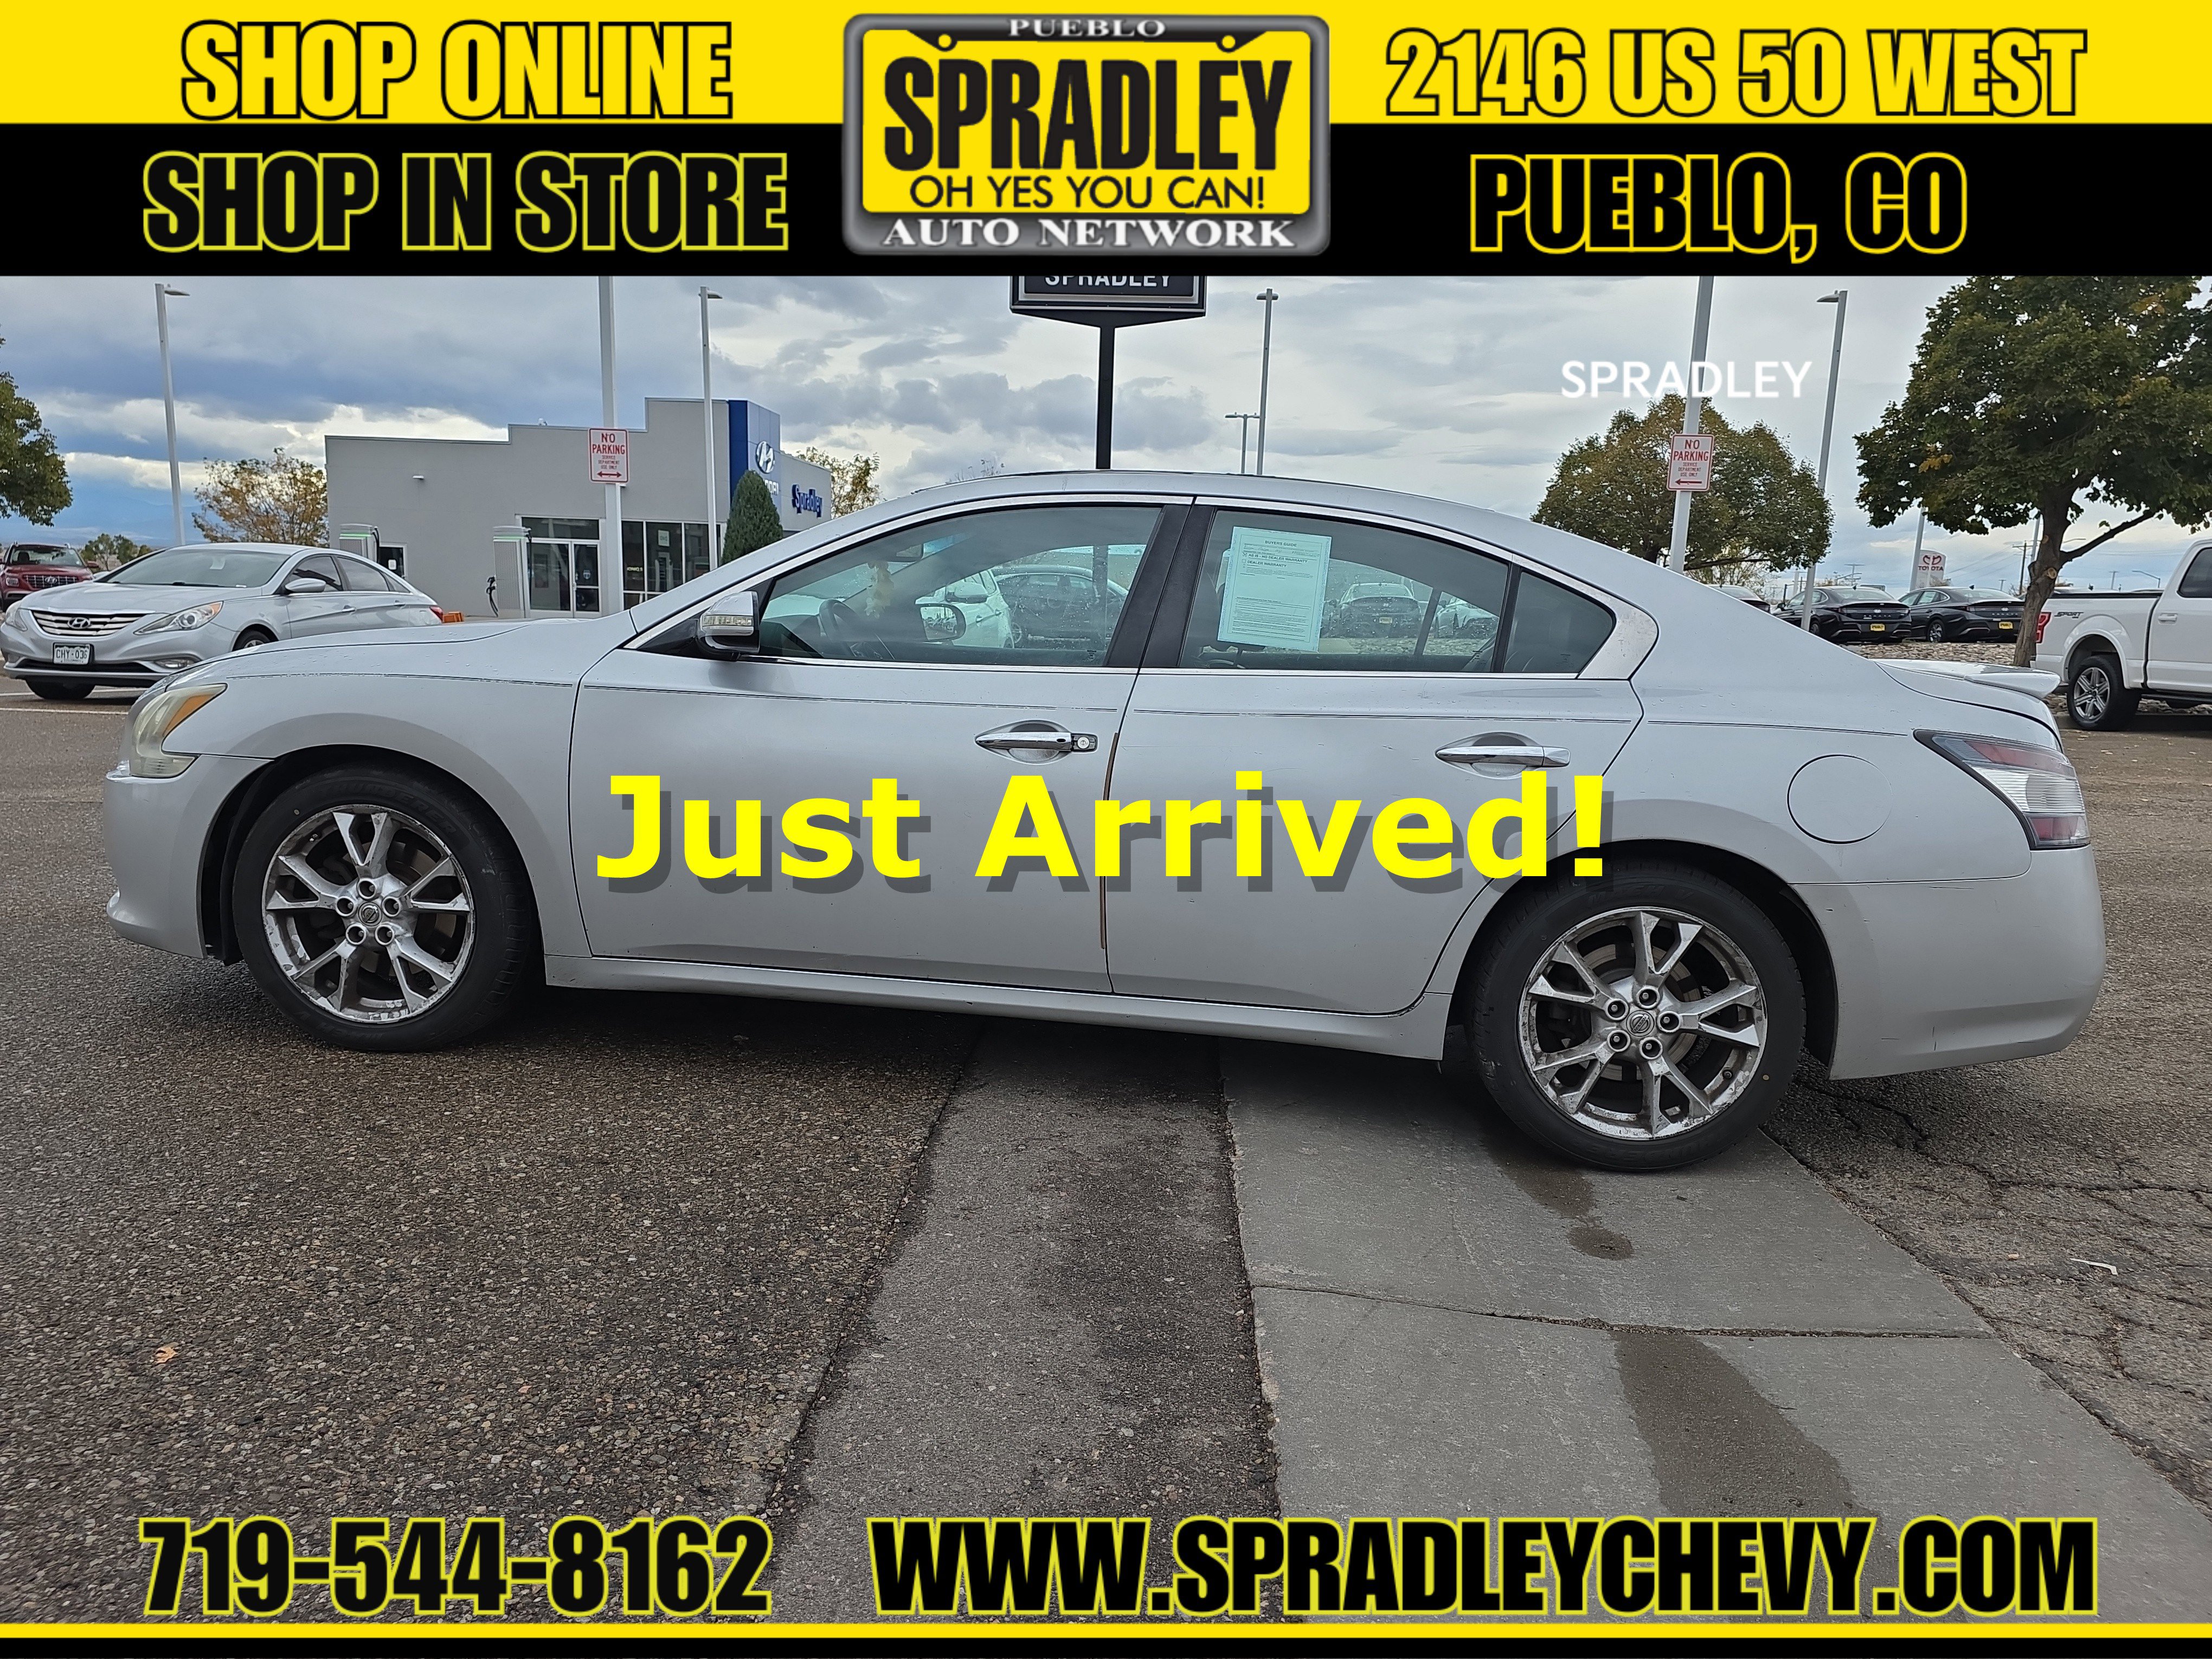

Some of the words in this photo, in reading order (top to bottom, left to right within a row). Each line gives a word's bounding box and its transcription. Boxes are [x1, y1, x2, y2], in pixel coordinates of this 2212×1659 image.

[1044, 275, 1171, 287] SPRADLEY
[601, 433, 615, 443] NO
[592, 444, 625, 454] PARKING
[1684, 439, 1700, 449] NO
[1673, 451, 1709, 461] PARKING
[792, 484, 822, 518] Spradley
